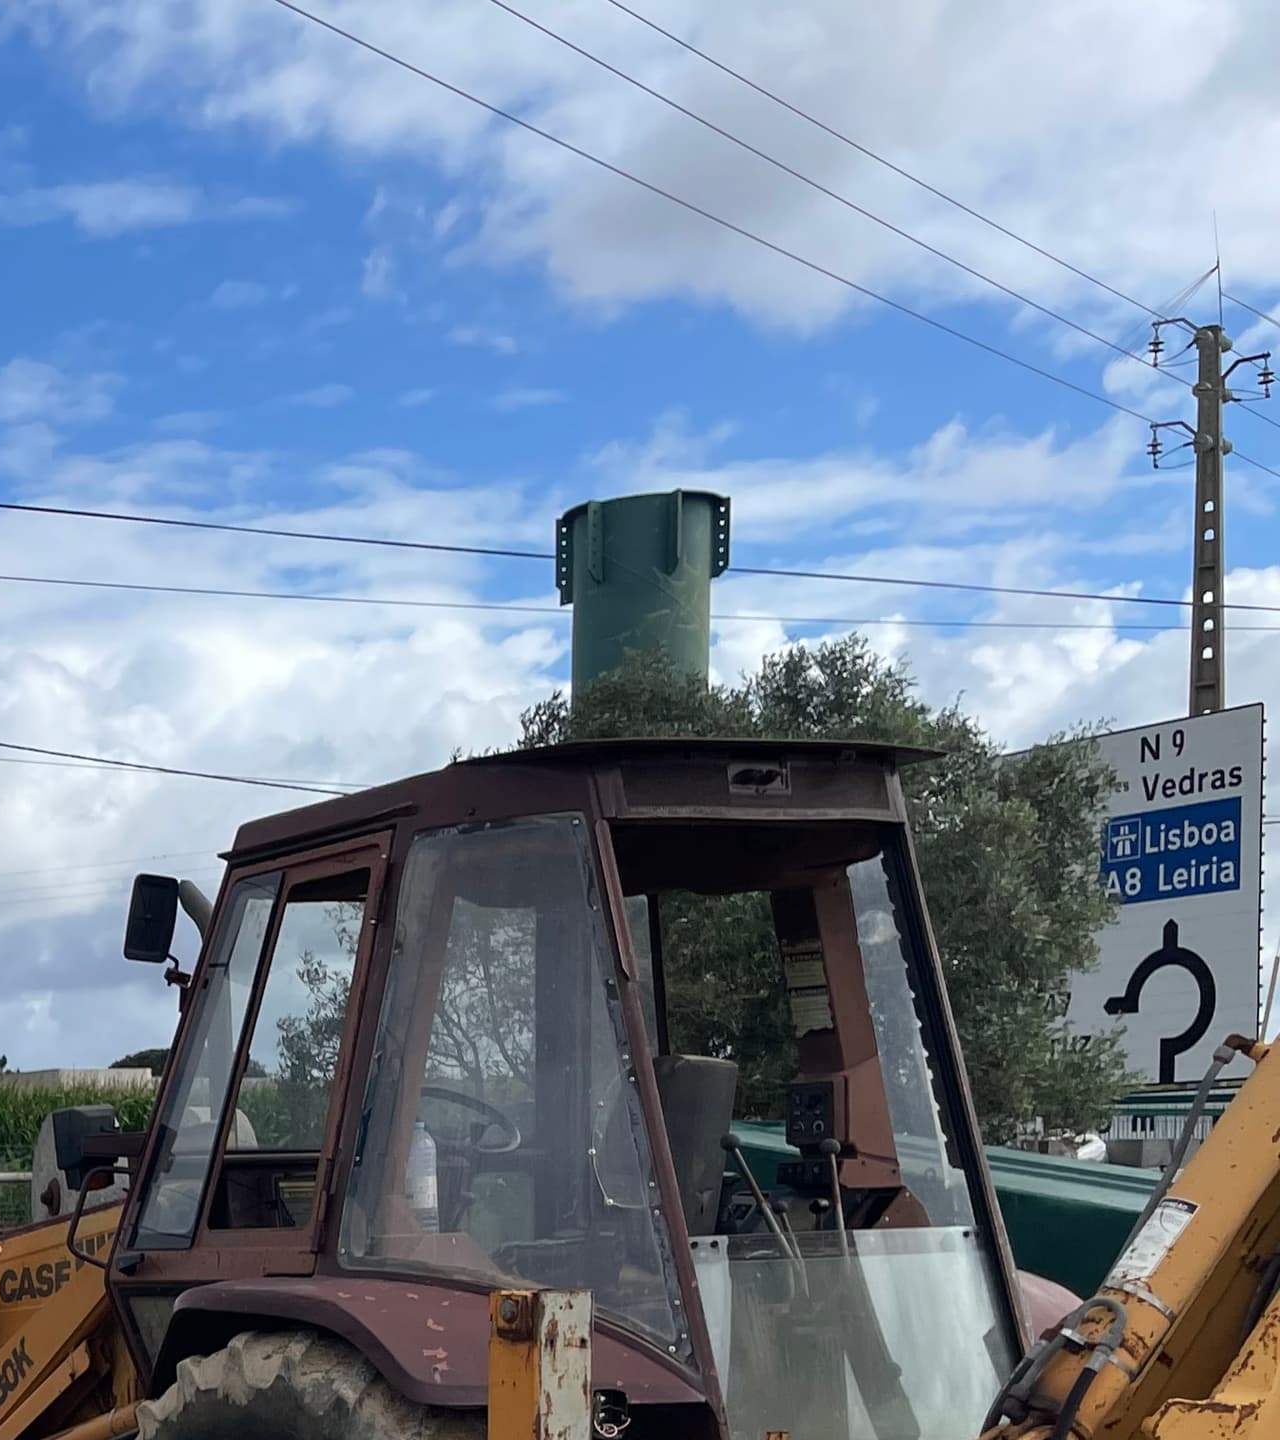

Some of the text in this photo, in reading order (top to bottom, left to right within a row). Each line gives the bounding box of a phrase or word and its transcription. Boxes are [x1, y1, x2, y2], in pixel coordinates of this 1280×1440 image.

[1141, 729, 1185, 763] N 9
[1142, 766, 1242, 802] Vedras
[1145, 819, 1235, 854] Lisboa
[1104, 856, 1235, 898] A8 Leiria
